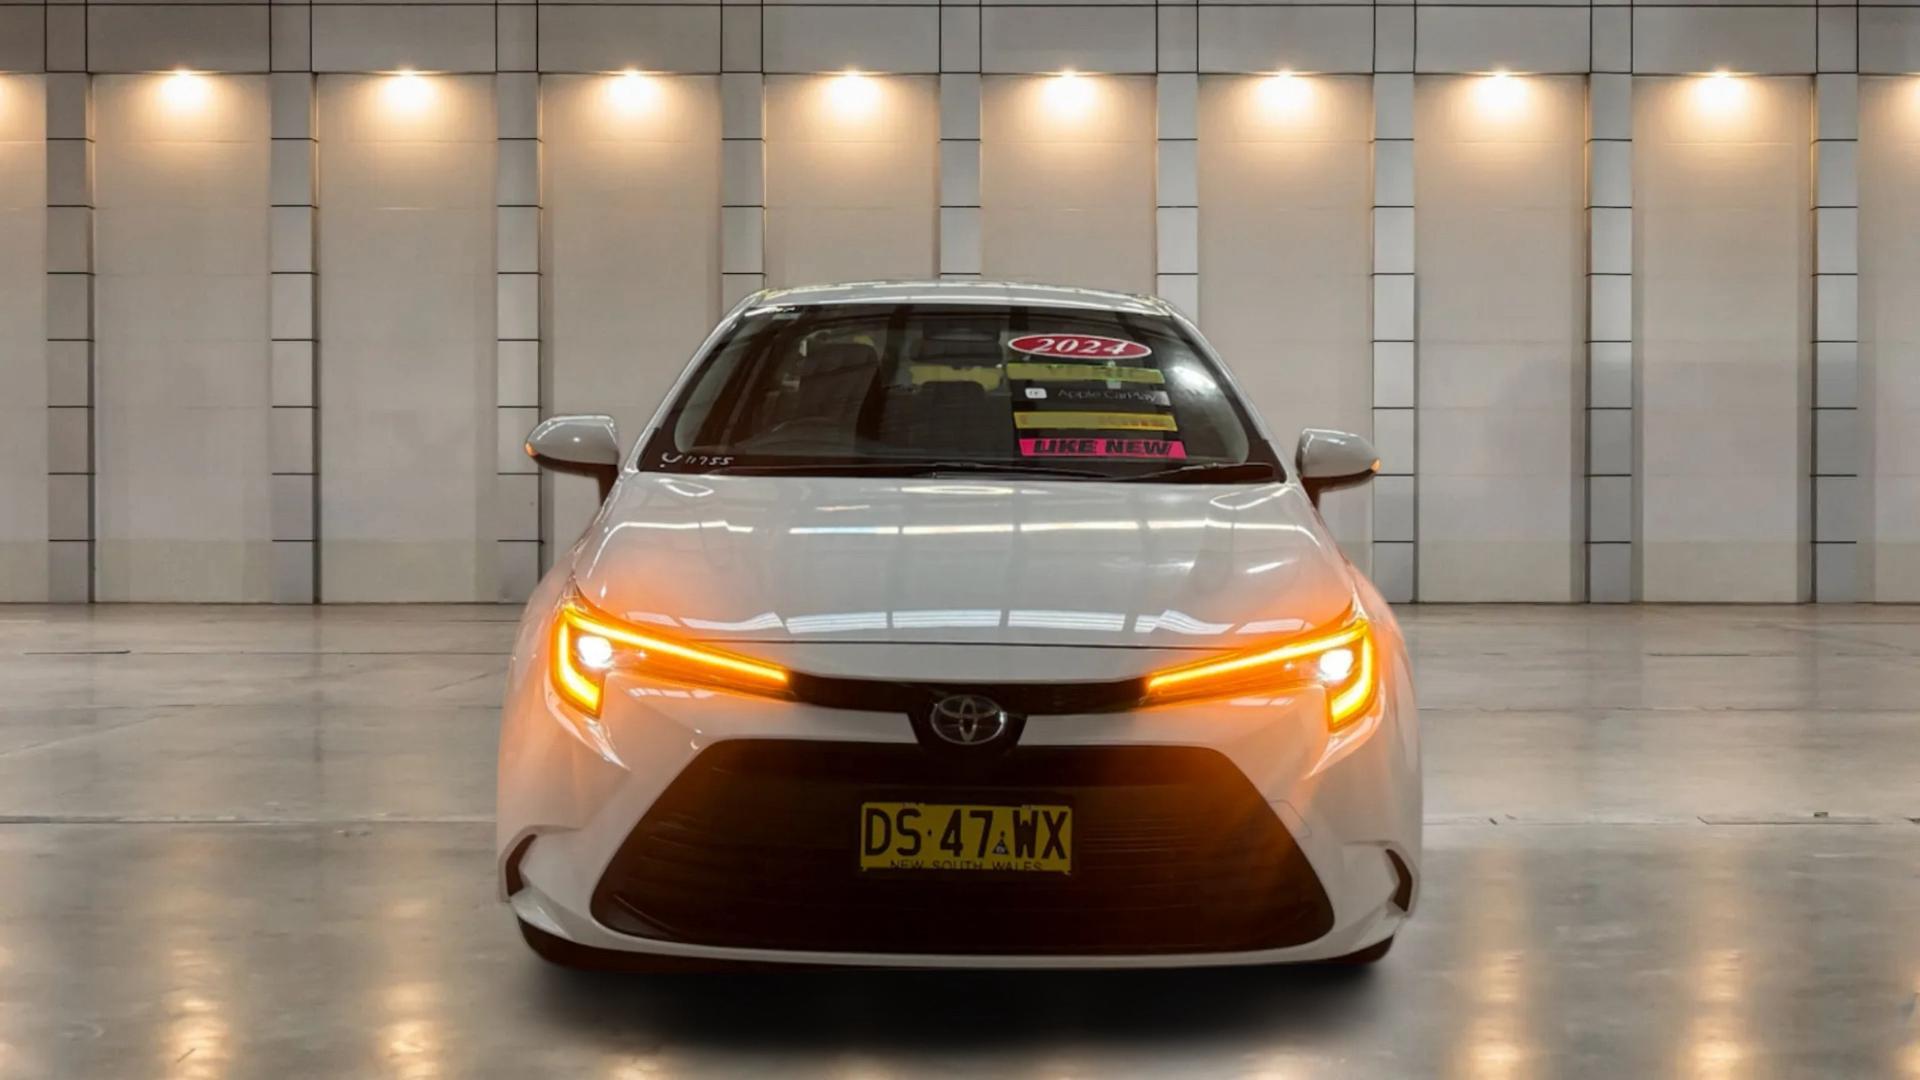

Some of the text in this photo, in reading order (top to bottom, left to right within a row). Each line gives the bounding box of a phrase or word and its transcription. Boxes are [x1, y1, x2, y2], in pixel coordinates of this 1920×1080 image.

[1033, 338, 1127, 355] 2024
[1058, 389, 1100, 400] Apple
[1033, 439, 1169, 455] LIKE NEW
[890, 860, 1042, 871] NEW SOUTH WALES
